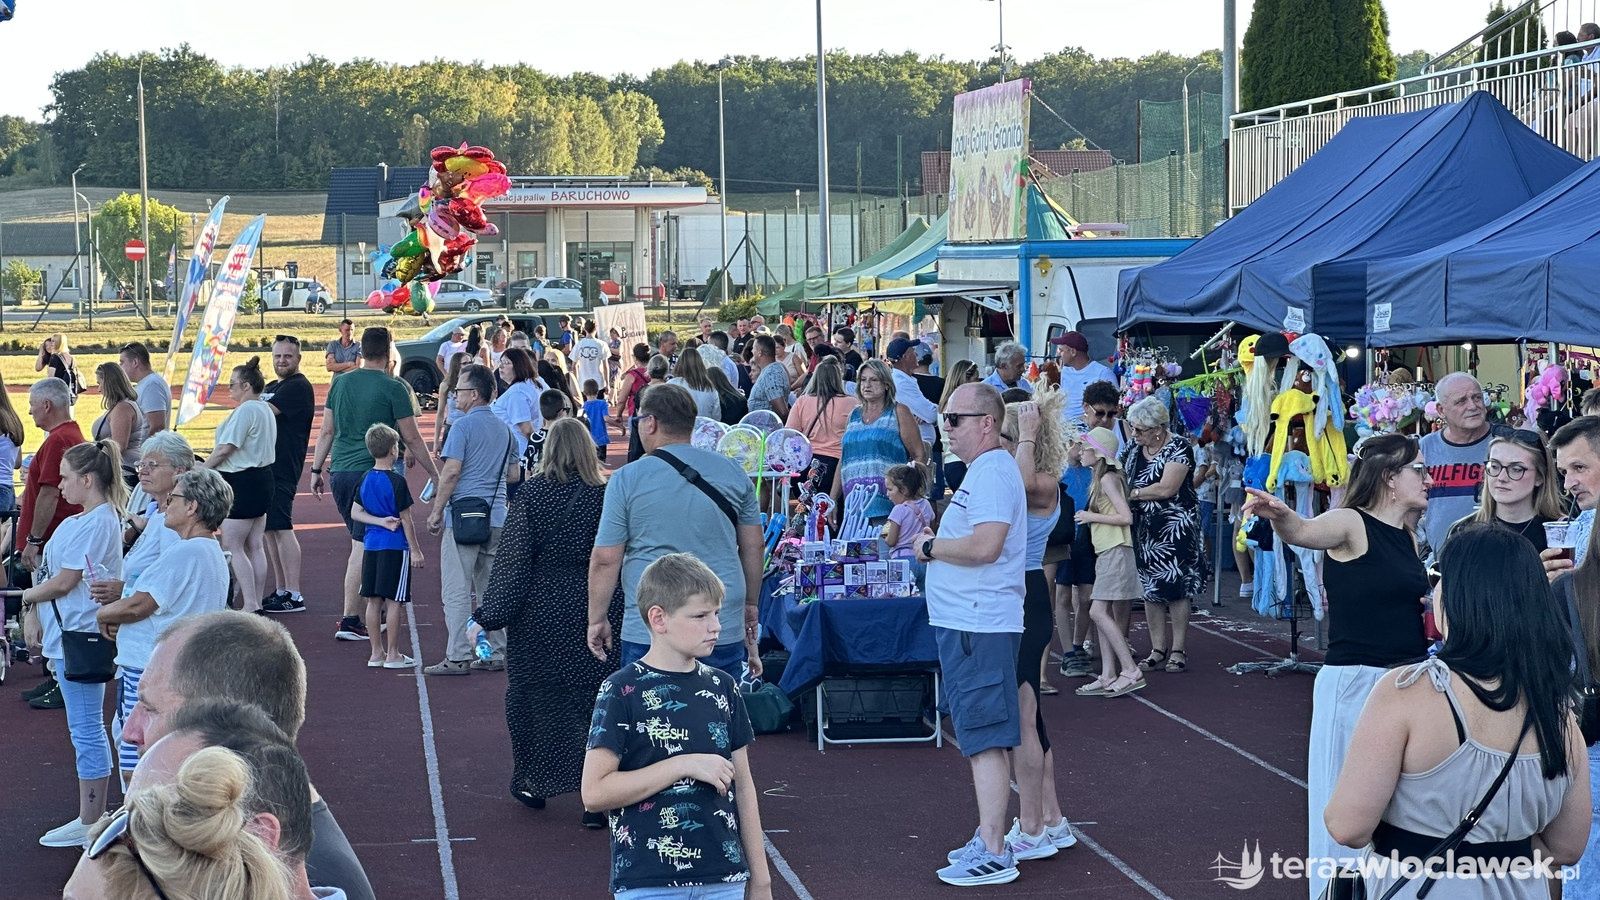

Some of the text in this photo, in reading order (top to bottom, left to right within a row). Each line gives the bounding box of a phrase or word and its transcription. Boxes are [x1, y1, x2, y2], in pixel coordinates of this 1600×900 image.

[523, 193, 546, 204] paliw
[551, 190, 630, 201] BARUCHOWO
[643, 248, 648, 258] 2
[649, 728, 690, 740] FRESH!
[658, 847, 702, 859] FRESH!
